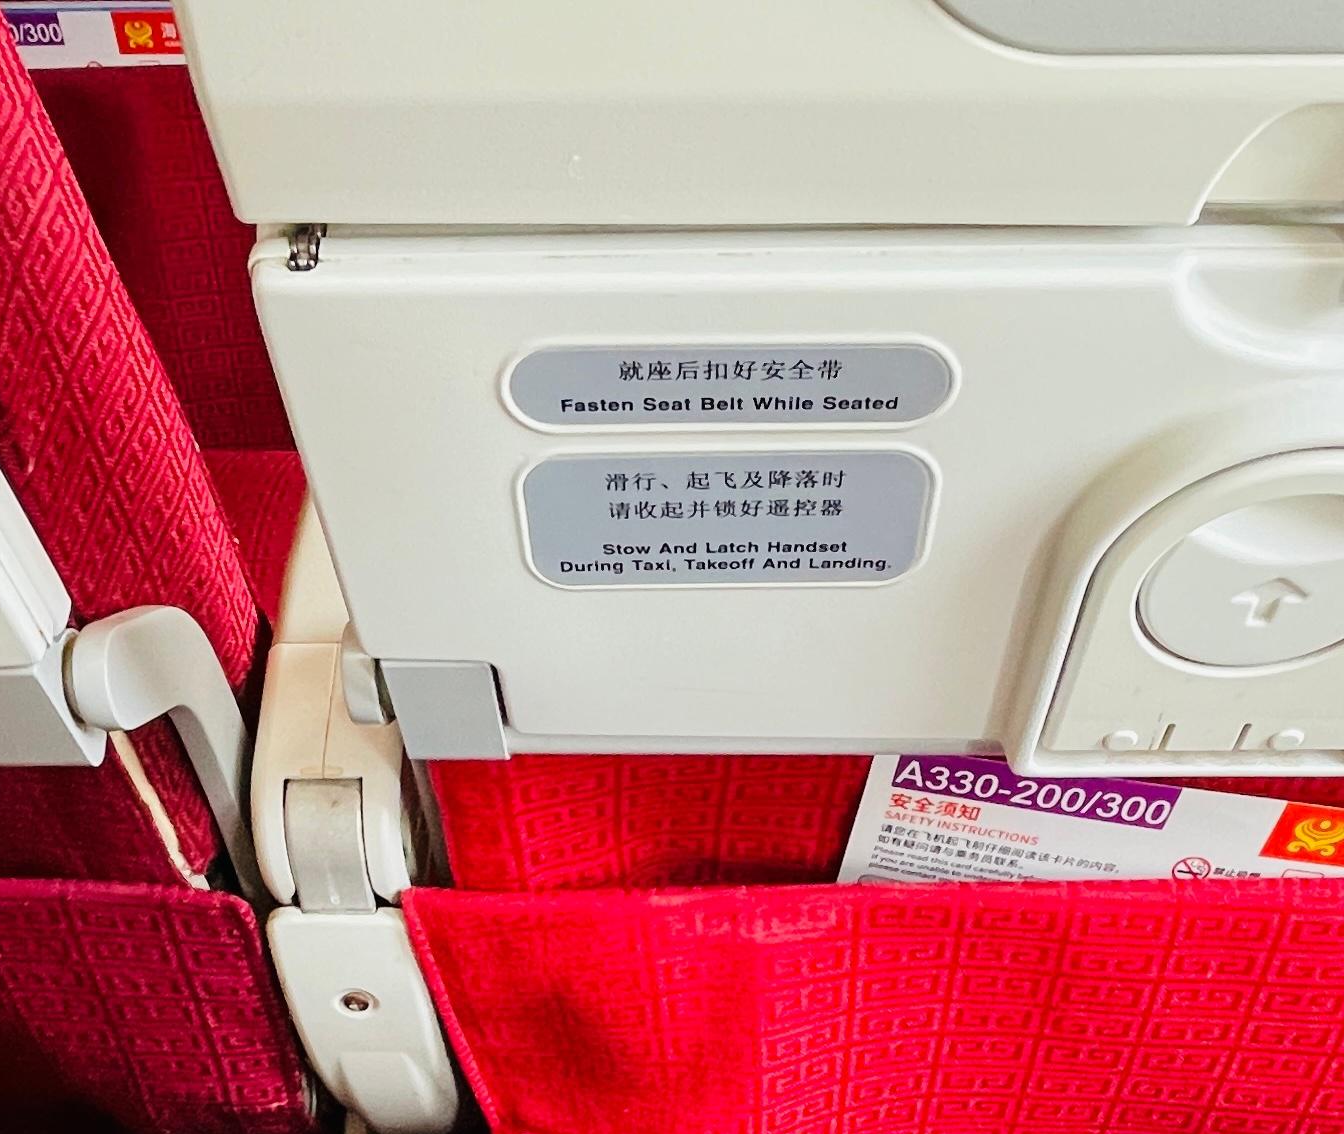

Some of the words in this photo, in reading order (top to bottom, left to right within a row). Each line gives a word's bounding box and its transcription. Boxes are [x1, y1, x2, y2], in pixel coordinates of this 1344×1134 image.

[619, 360, 843, 381] 就座后扣好安全带
[560, 398, 634, 413] Fasten
[643, 397, 691, 412] Seat
[701, 396, 743, 411] Belt
[753, 396, 813, 411] While
[823, 396, 899, 411] Seated
[605, 469, 847, 492] 滑行、起飞及降落时
[609, 499, 843, 520] 请收起并锁好遥控器
[602, 543, 651, 555] Stow
[660, 543, 697, 554] And
[706, 542, 759, 554] Latch
[767, 541, 848, 554] Handset
[560, 560, 624, 575] During
[684, 559, 756, 571] Takeoff
[763, 558, 801, 570] And
[808, 558, 893, 573] Landing.
[895, 760, 1173, 825] A330-200/300
[888, 793, 982, 821] 安全须知
[884, 810, 935, 828] SAFETY
[937, 819, 1040, 846] INSTRUCTIONS
